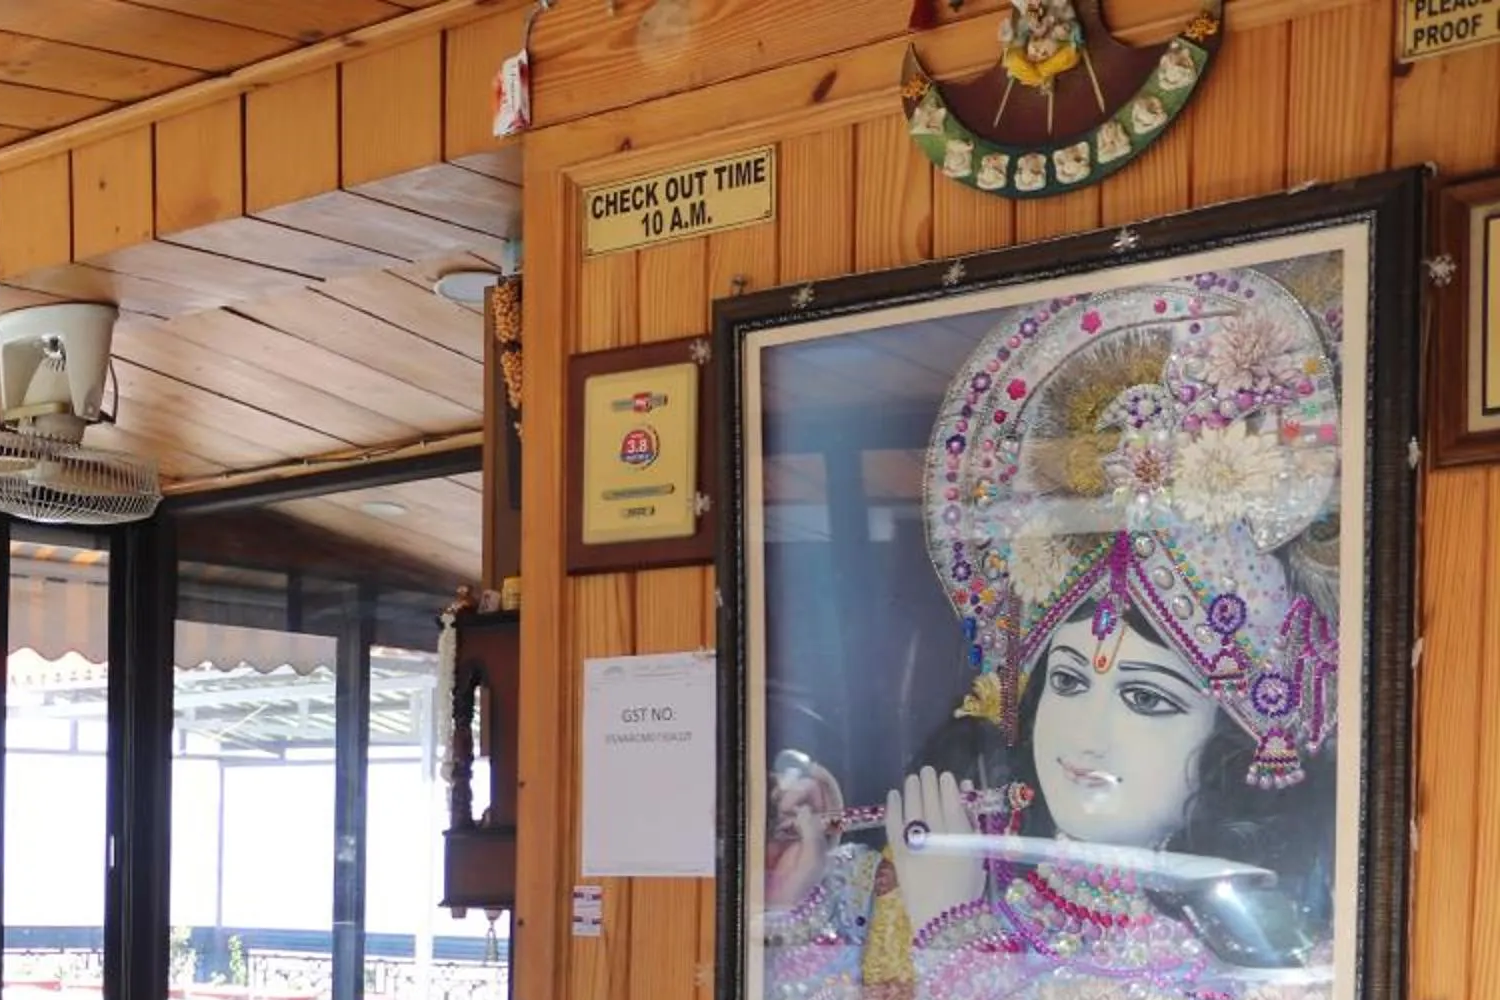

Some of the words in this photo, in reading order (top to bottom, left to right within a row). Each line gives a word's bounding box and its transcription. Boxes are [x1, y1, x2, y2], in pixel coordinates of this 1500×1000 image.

[1415, 0, 1492, 20] PLEA
[1413, 13, 1483, 50] PROOF
[591, 182, 659, 219] CHECK
[665, 169, 708, 203] OUT
[714, 157, 766, 191] TIME
[641, 210, 664, 237] 10
[670, 200, 713, 233] A.M.
[621, 707, 647, 723] GST
